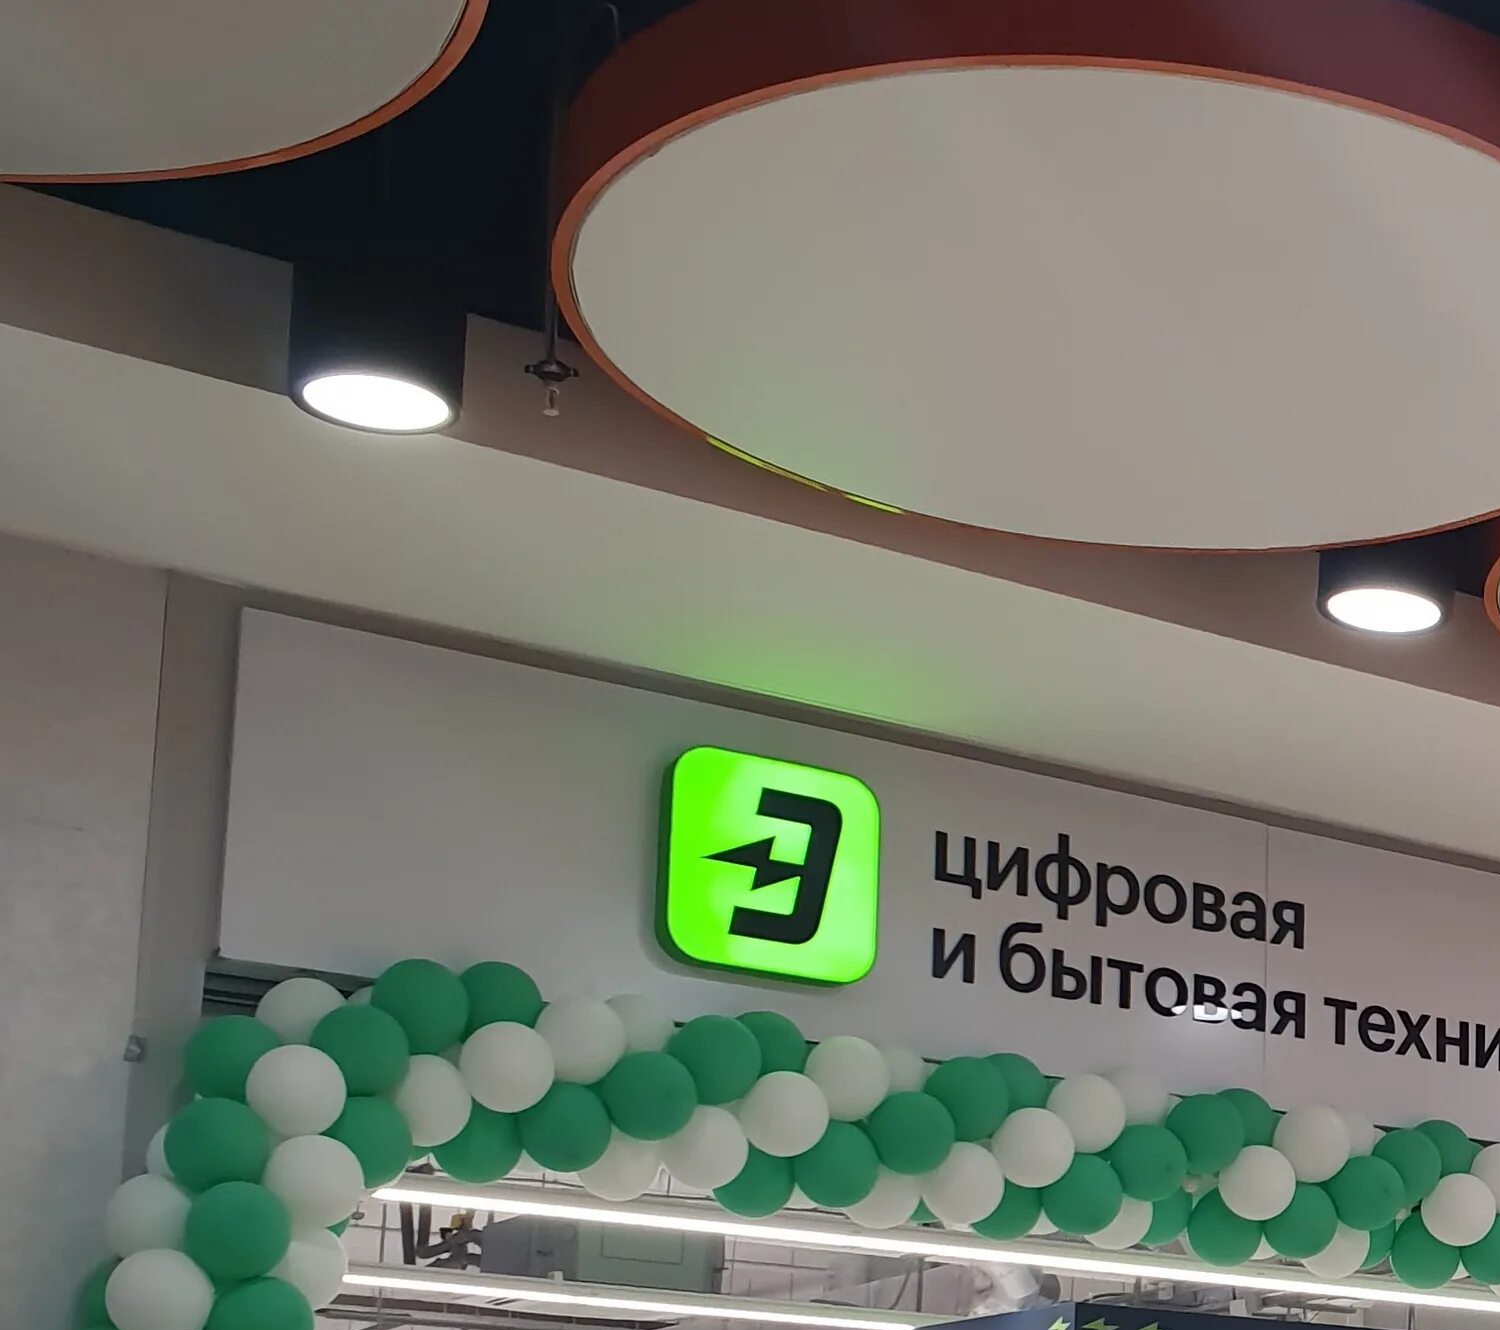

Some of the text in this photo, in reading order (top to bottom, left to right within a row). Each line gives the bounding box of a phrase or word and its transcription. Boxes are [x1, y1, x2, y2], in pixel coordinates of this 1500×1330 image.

[933, 828, 1307, 950] цифровая
[932, 922, 977, 985] и
[999, 920, 1307, 1040] бытовая
